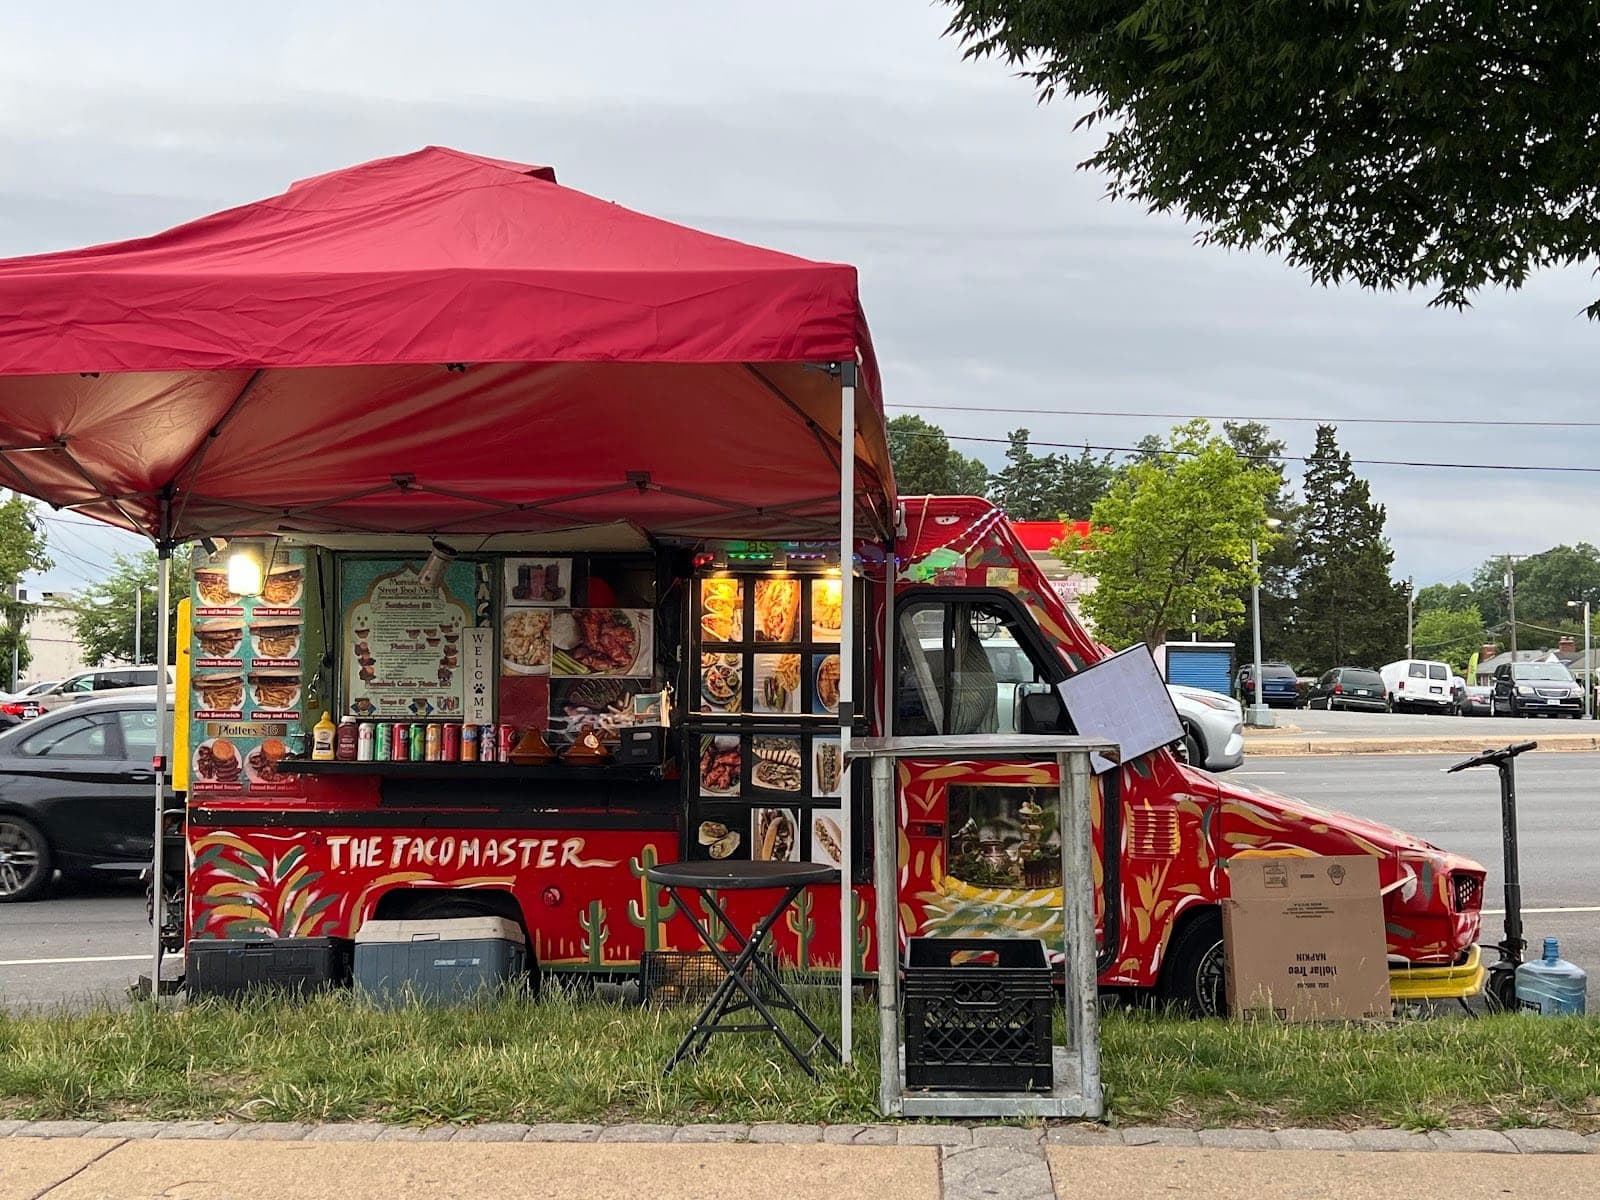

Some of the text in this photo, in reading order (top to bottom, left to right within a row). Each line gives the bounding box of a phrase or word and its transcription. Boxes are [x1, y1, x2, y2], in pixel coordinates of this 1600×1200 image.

[217, 660, 243, 668] Sandwich
[253, 659, 299, 667] Liver Sandwich
[196, 711, 241, 719] Fish Sandwich
[327, 835, 384, 868] THE
[1296, 953, 1326, 962] NAPKIN
[1288, 965, 1308, 977] Tree
